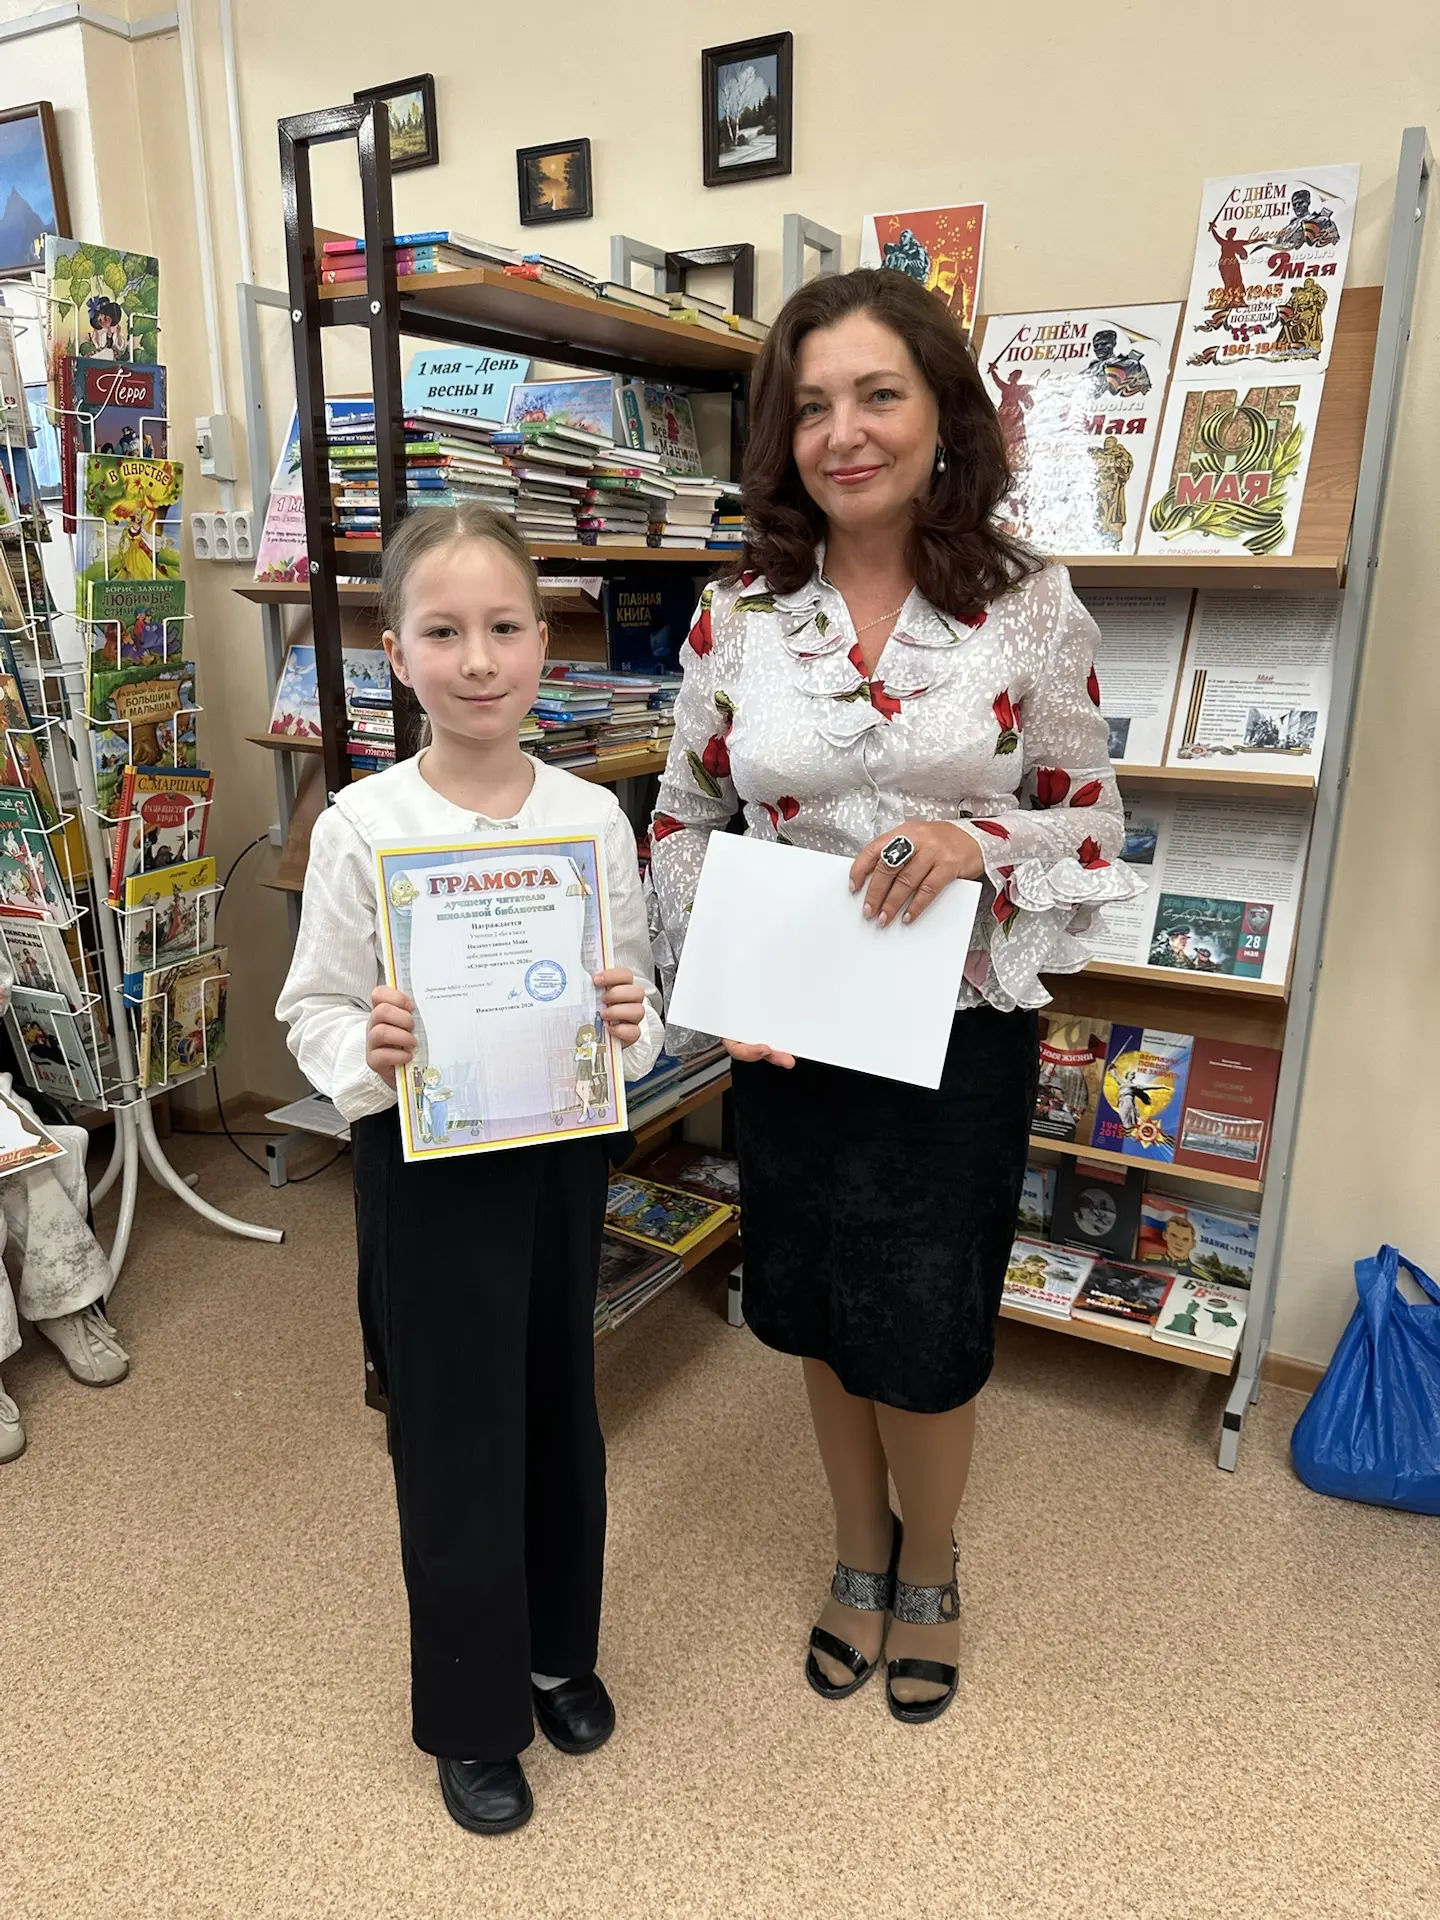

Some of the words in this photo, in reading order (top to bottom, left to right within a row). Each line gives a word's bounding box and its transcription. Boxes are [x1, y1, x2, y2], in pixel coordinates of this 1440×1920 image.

[1230, 188, 1241, 202] С
[1242, 182, 1287, 204] ДНЁМ
[1222, 201, 1291, 221] ПОБЕДЫ!
[1280, 262, 1338, 280] Мая
[1018, 327, 1031, 342] С
[1032, 321, 1088, 344] ДНЁМ
[1006, 343, 1092, 362] ПОБЕДЫ!
[417, 362, 427, 376] 1
[430, 362, 462, 375] мая
[475, 357, 519, 375] День
[427, 384, 479, 398] весны
[482, 383, 494, 396] и
[650, 422, 668, 439] Всё
[108, 470, 119, 483] В
[122, 463, 170, 486] ЦАРСТВЕ
[1176, 470, 1274, 507] МАЯ
[277, 497, 286, 512] 1
[618, 592, 661, 606] ГЛАВНАЯ
[617, 607, 652, 622] КНИГА
[125, 691, 171, 707] БОЛЬШИМ
[129, 700, 178, 717] МАЛЫШАМ
[150, 778, 205, 792] МАРШАК
[428, 868, 559, 896] ГРАМОТА
[436, 906, 492, 922] школьной
[494, 902, 556, 916] библиотеки
[1245, 934, 1262, 949] 28
